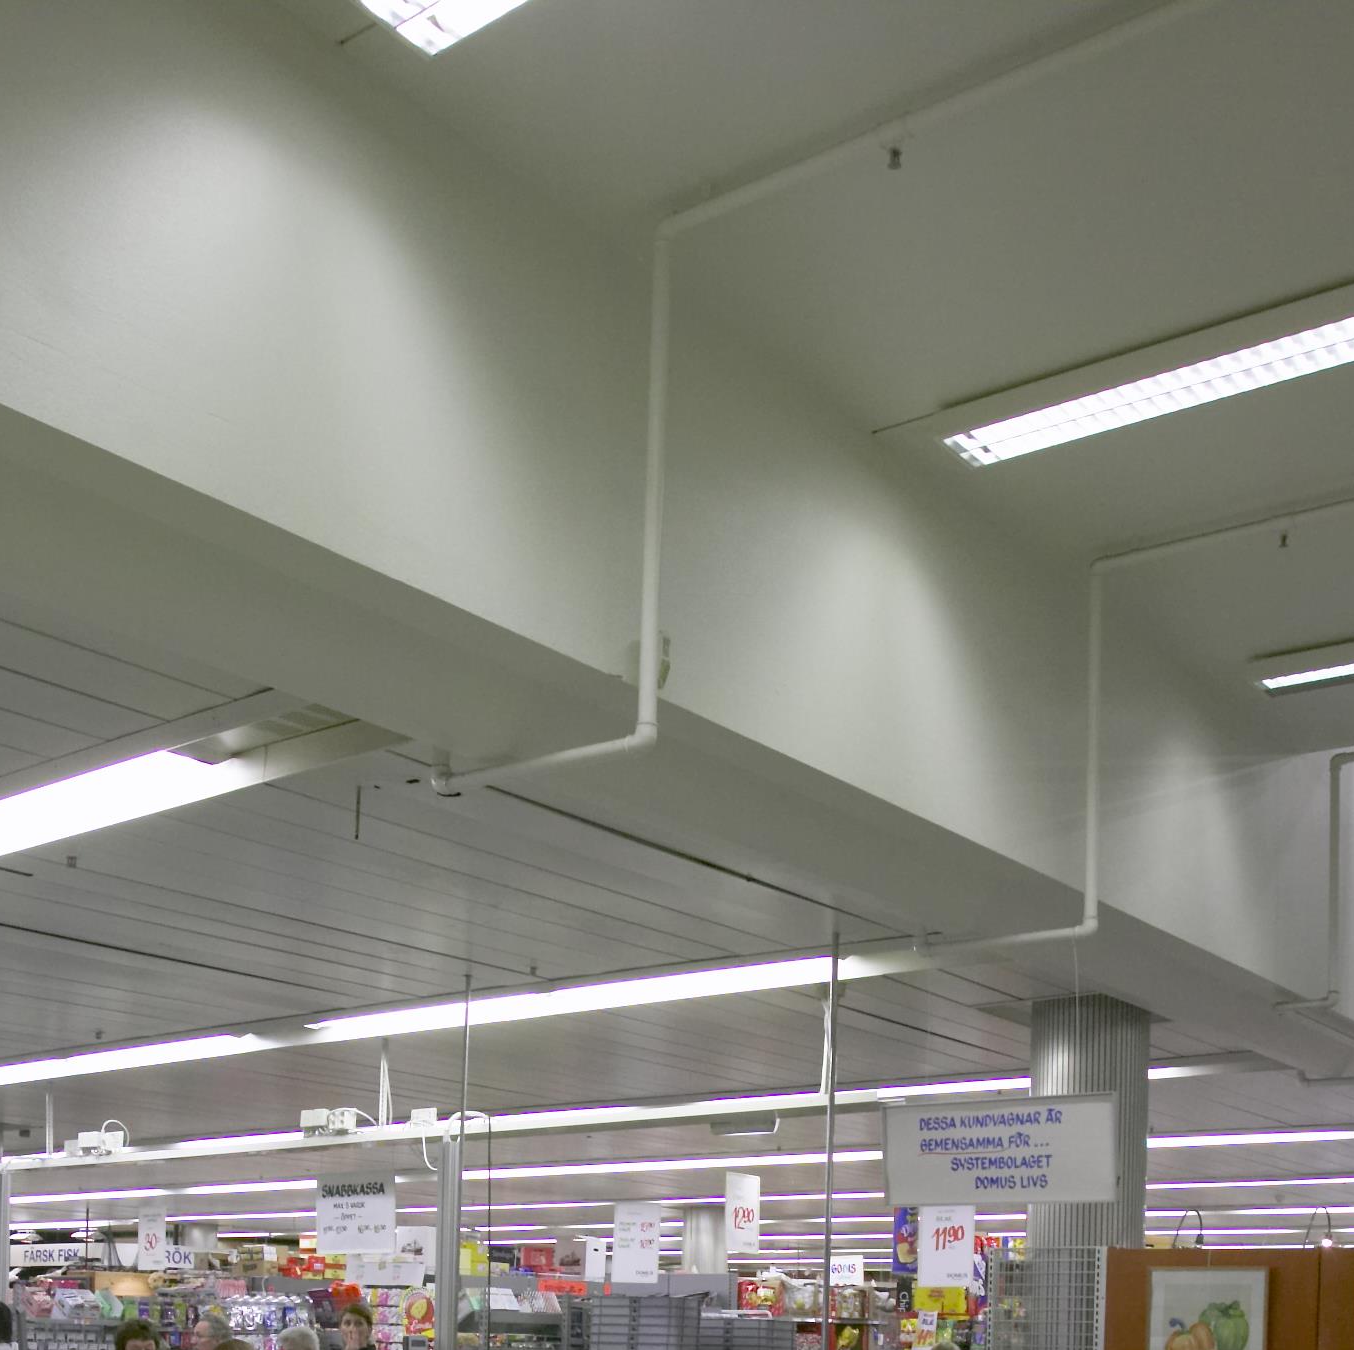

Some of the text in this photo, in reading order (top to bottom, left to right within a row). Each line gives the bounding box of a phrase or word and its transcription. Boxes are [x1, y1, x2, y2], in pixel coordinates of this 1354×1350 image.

[919, 1108, 1063, 1131] DESSA KUNDVAGNAR ÄR
[920, 1136, 1004, 1152] GEMENSAMMA
[950, 1154, 1053, 1172] SYSTEMBOLAGET
[321, 1181, 386, 1198] SNABBKASSA
[975, 1174, 1048, 1190] DOMUS LIVS
